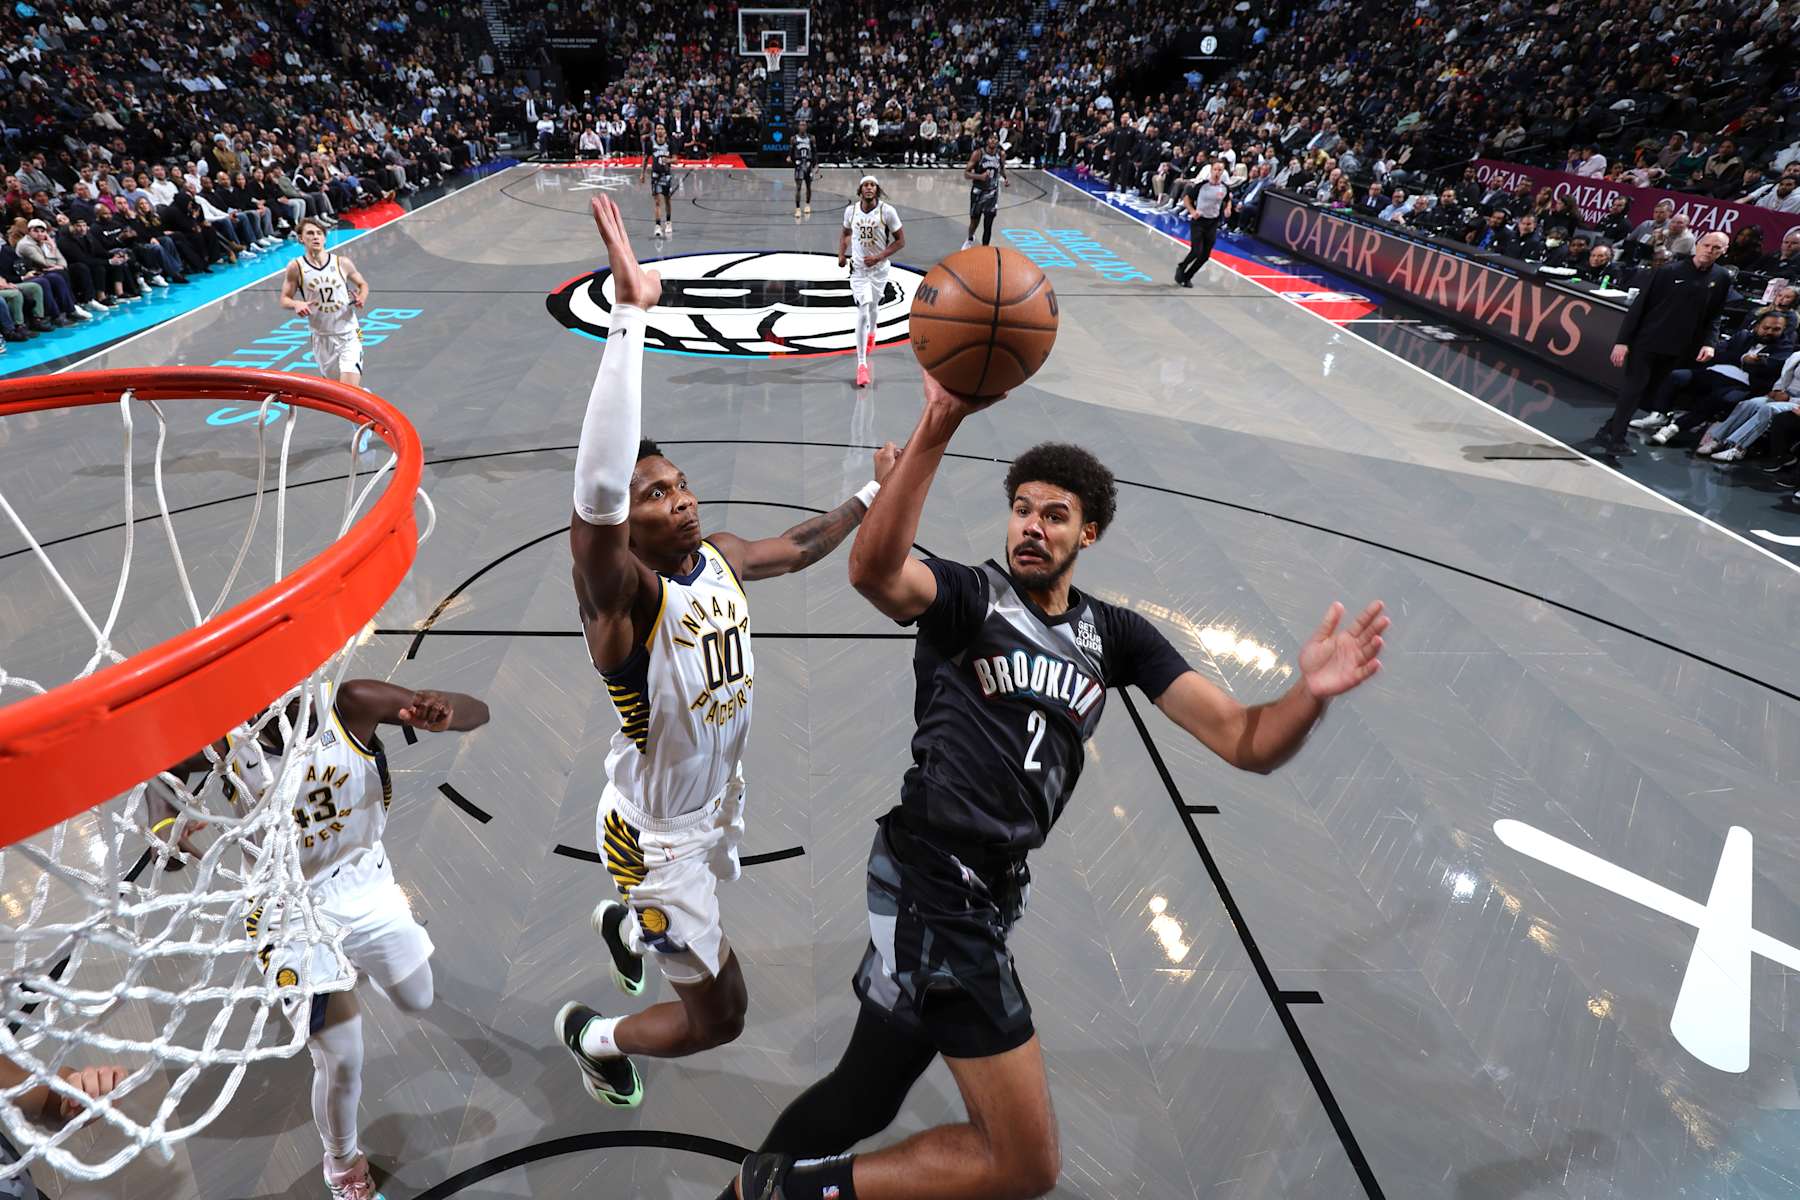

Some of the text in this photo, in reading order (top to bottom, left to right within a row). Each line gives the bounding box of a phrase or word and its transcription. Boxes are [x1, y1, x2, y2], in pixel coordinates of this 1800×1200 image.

[860, 226, 873, 239] 33
[1001, 228, 1078, 268] CENTER
[1045, 228, 1153, 282] BARCLAYS
[319, 287, 335, 303] 12
[1284, 207, 1592, 357] QATAR AIRWAYS
[672, 595, 749, 648] INDANA
[1077, 628, 1102, 643] YOUR
[1078, 620, 1096, 634] GET
[702, 625, 744, 692] 00
[1075, 637, 1104, 654] GUIDE
[688, 674, 753, 727] PACERS
[973, 649, 1104, 718] BROOKLYN
[1023, 709, 1048, 772] 2
[303, 808, 352, 849] CERS
